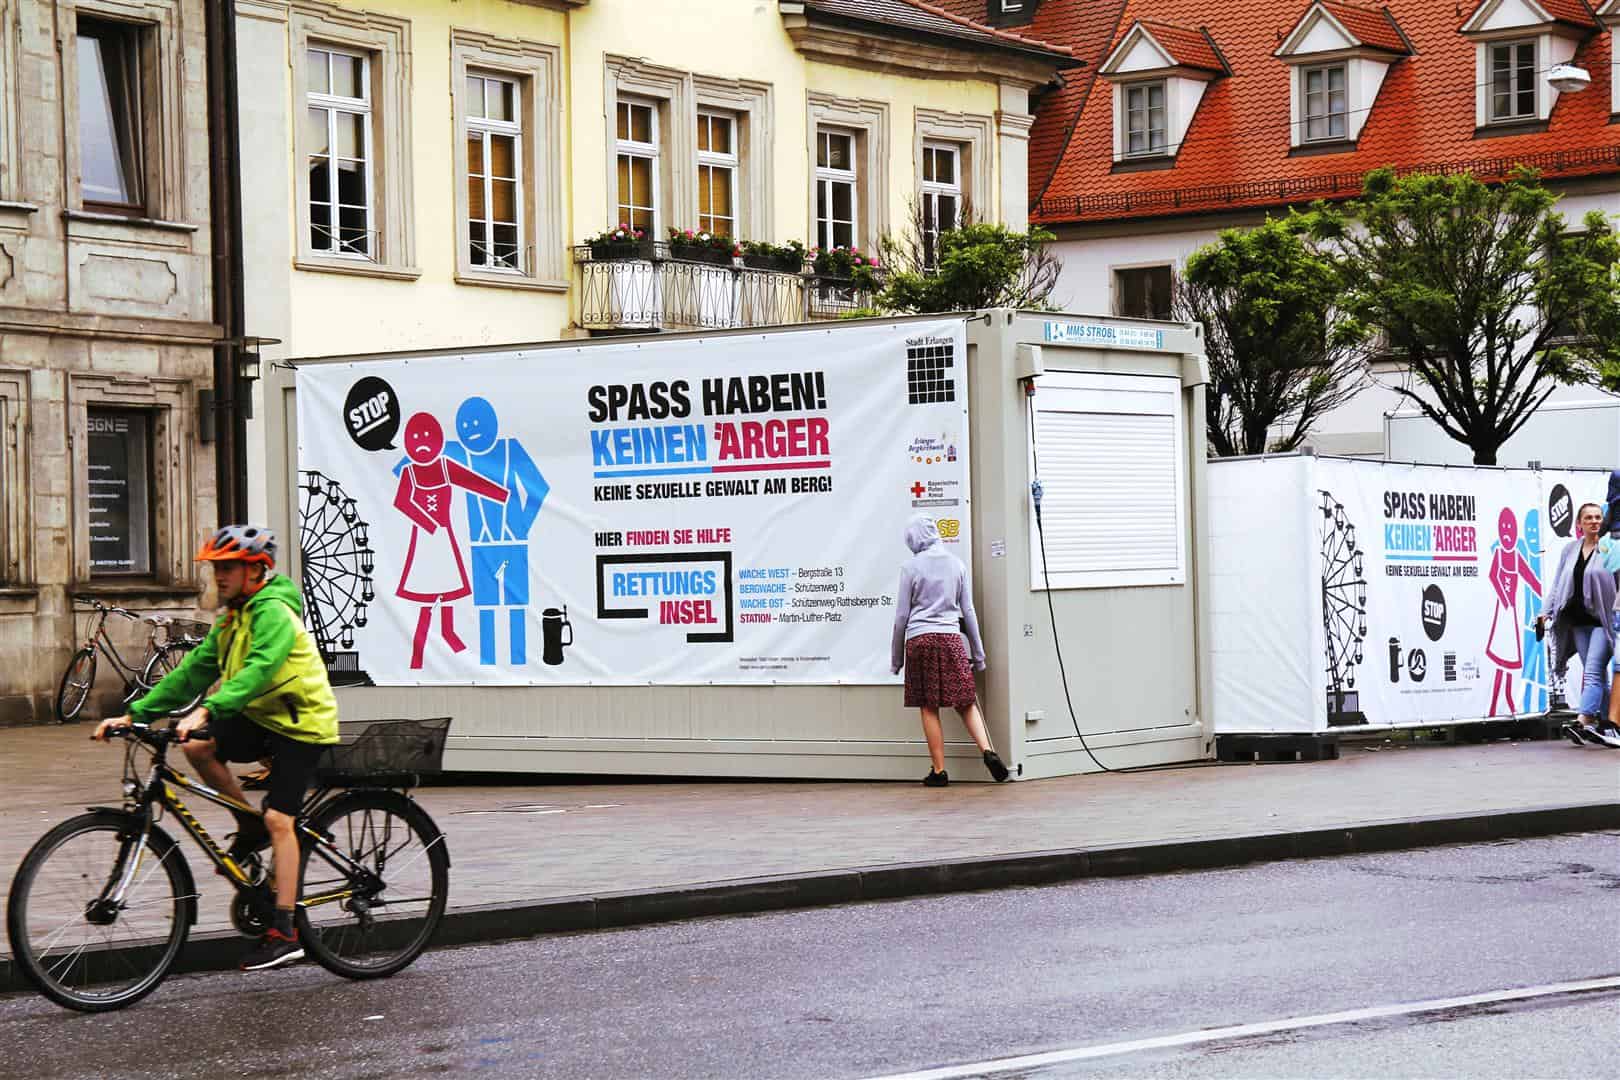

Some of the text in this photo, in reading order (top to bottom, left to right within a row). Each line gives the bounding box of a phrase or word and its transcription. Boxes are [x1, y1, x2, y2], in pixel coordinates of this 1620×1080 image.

[1067, 325, 1084, 337] MMS
[588, 371, 827, 423] SPASS HABEN!
[350, 392, 389, 429] STOP
[590, 424, 707, 466] KEINEN
[594, 475, 832, 502] KEINE SEXUELLE GEWALT AM BERG!
[1384, 491, 1476, 521] SPASS HABEN!
[1551, 495, 1569, 522] STOP
[595, 528, 731, 547] HIER FINDEN SIE HILFE
[1385, 524, 1431, 551] KEINEN
[613, 570, 716, 596] RETTUNGS
[739, 569, 766, 579] WACHE
[768, 568, 789, 578] WEST
[798, 568, 832, 579] Bergstraße
[834, 567, 844, 576] 13
[1385, 565, 1402, 576] KEINE
[1403, 566, 1429, 577] SEXUELLE
[1431, 566, 1451, 577] GEWALT
[1452, 566, 1461, 577] AM
[740, 584, 786, 594] BERGWACHE
[794, 583, 838, 594] Schützenweg
[840, 582, 844, 592] 3
[660, 600, 717, 624] INSEL
[740, 599, 766, 608] WACHE
[768, 599, 784, 608] OST
[881, 596, 893, 606] Str.
[1424, 600, 1444, 618] STOP
[740, 614, 772, 624] STATION
[778, 612, 842, 623] Martin-Luther-Platz
